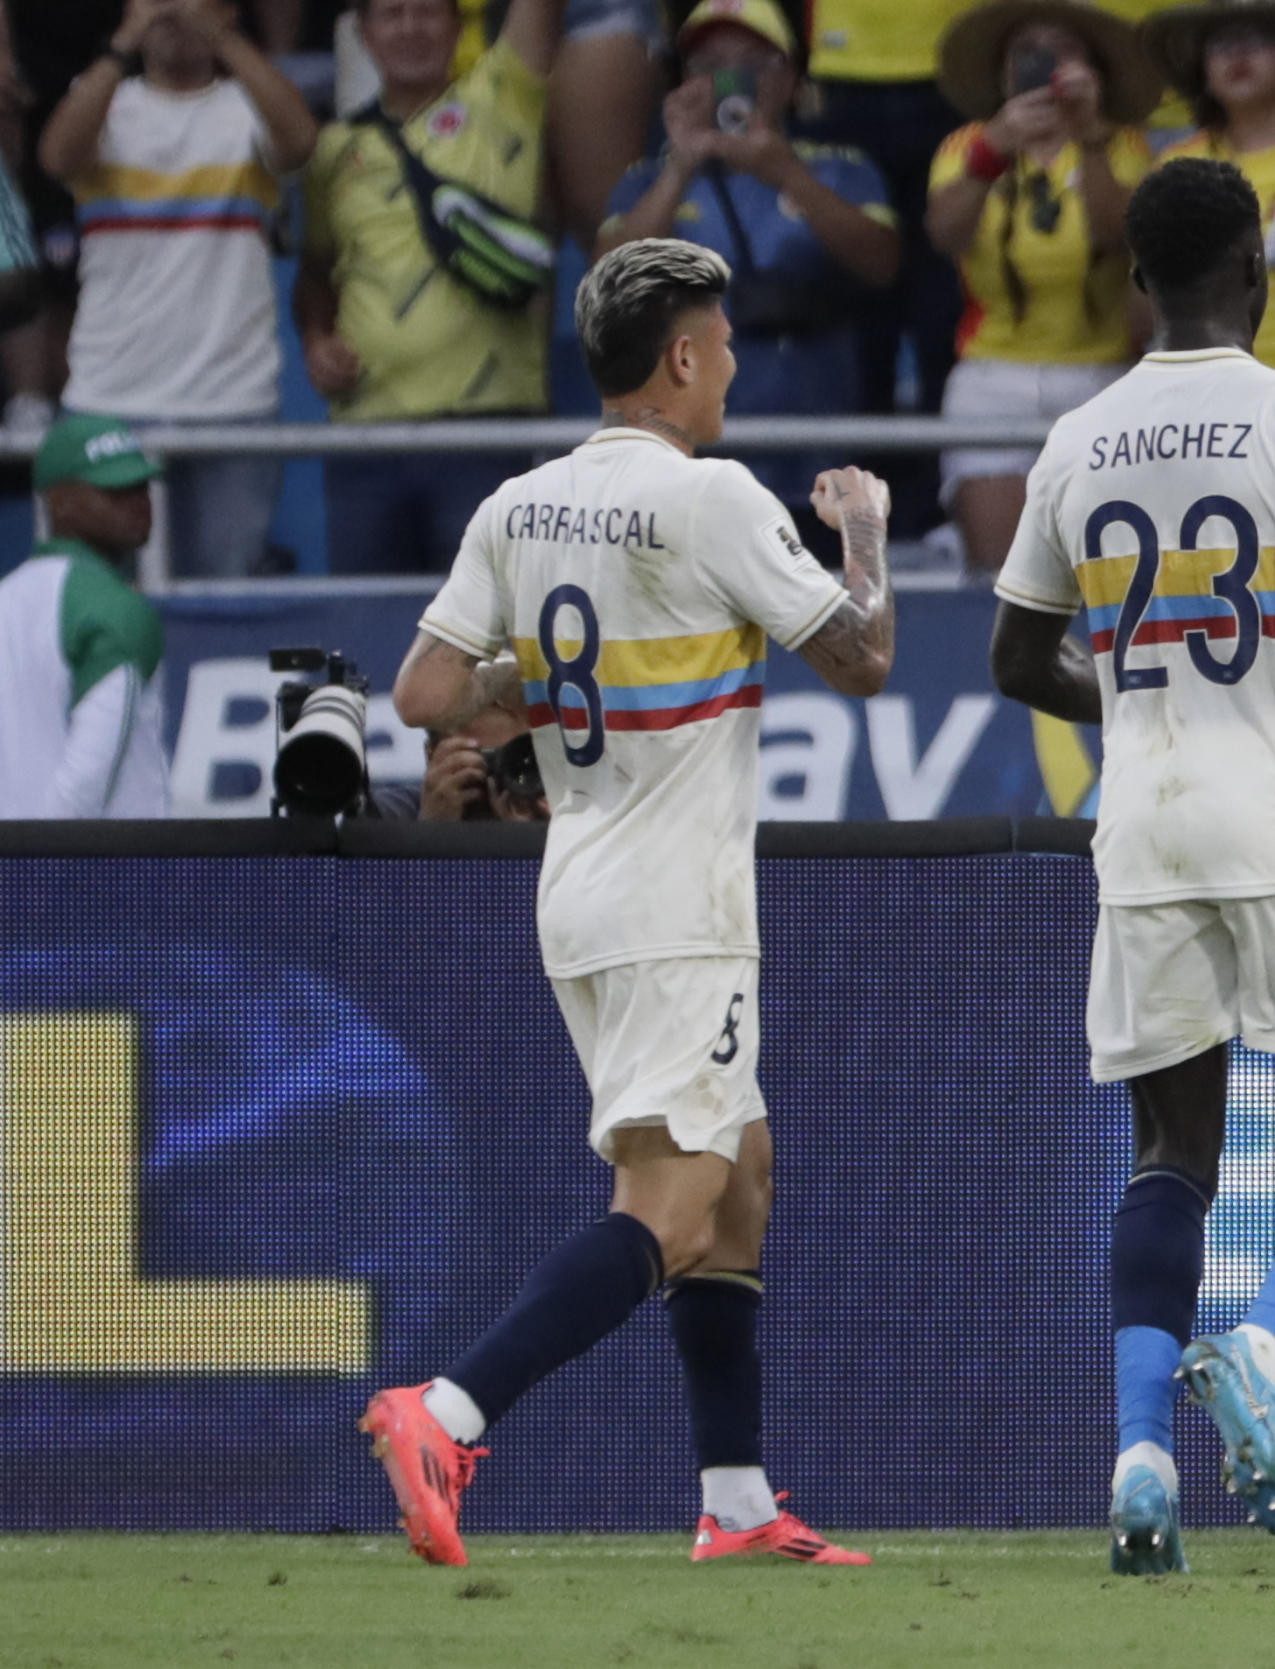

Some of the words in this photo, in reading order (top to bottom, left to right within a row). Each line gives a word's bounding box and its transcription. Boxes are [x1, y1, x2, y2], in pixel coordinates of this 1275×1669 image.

[1089, 423, 1252, 471] SANCHEZ
[506, 503, 665, 549] CARRASCAL
[1084, 495, 1259, 694] 23
[538, 584, 604, 767] 8
